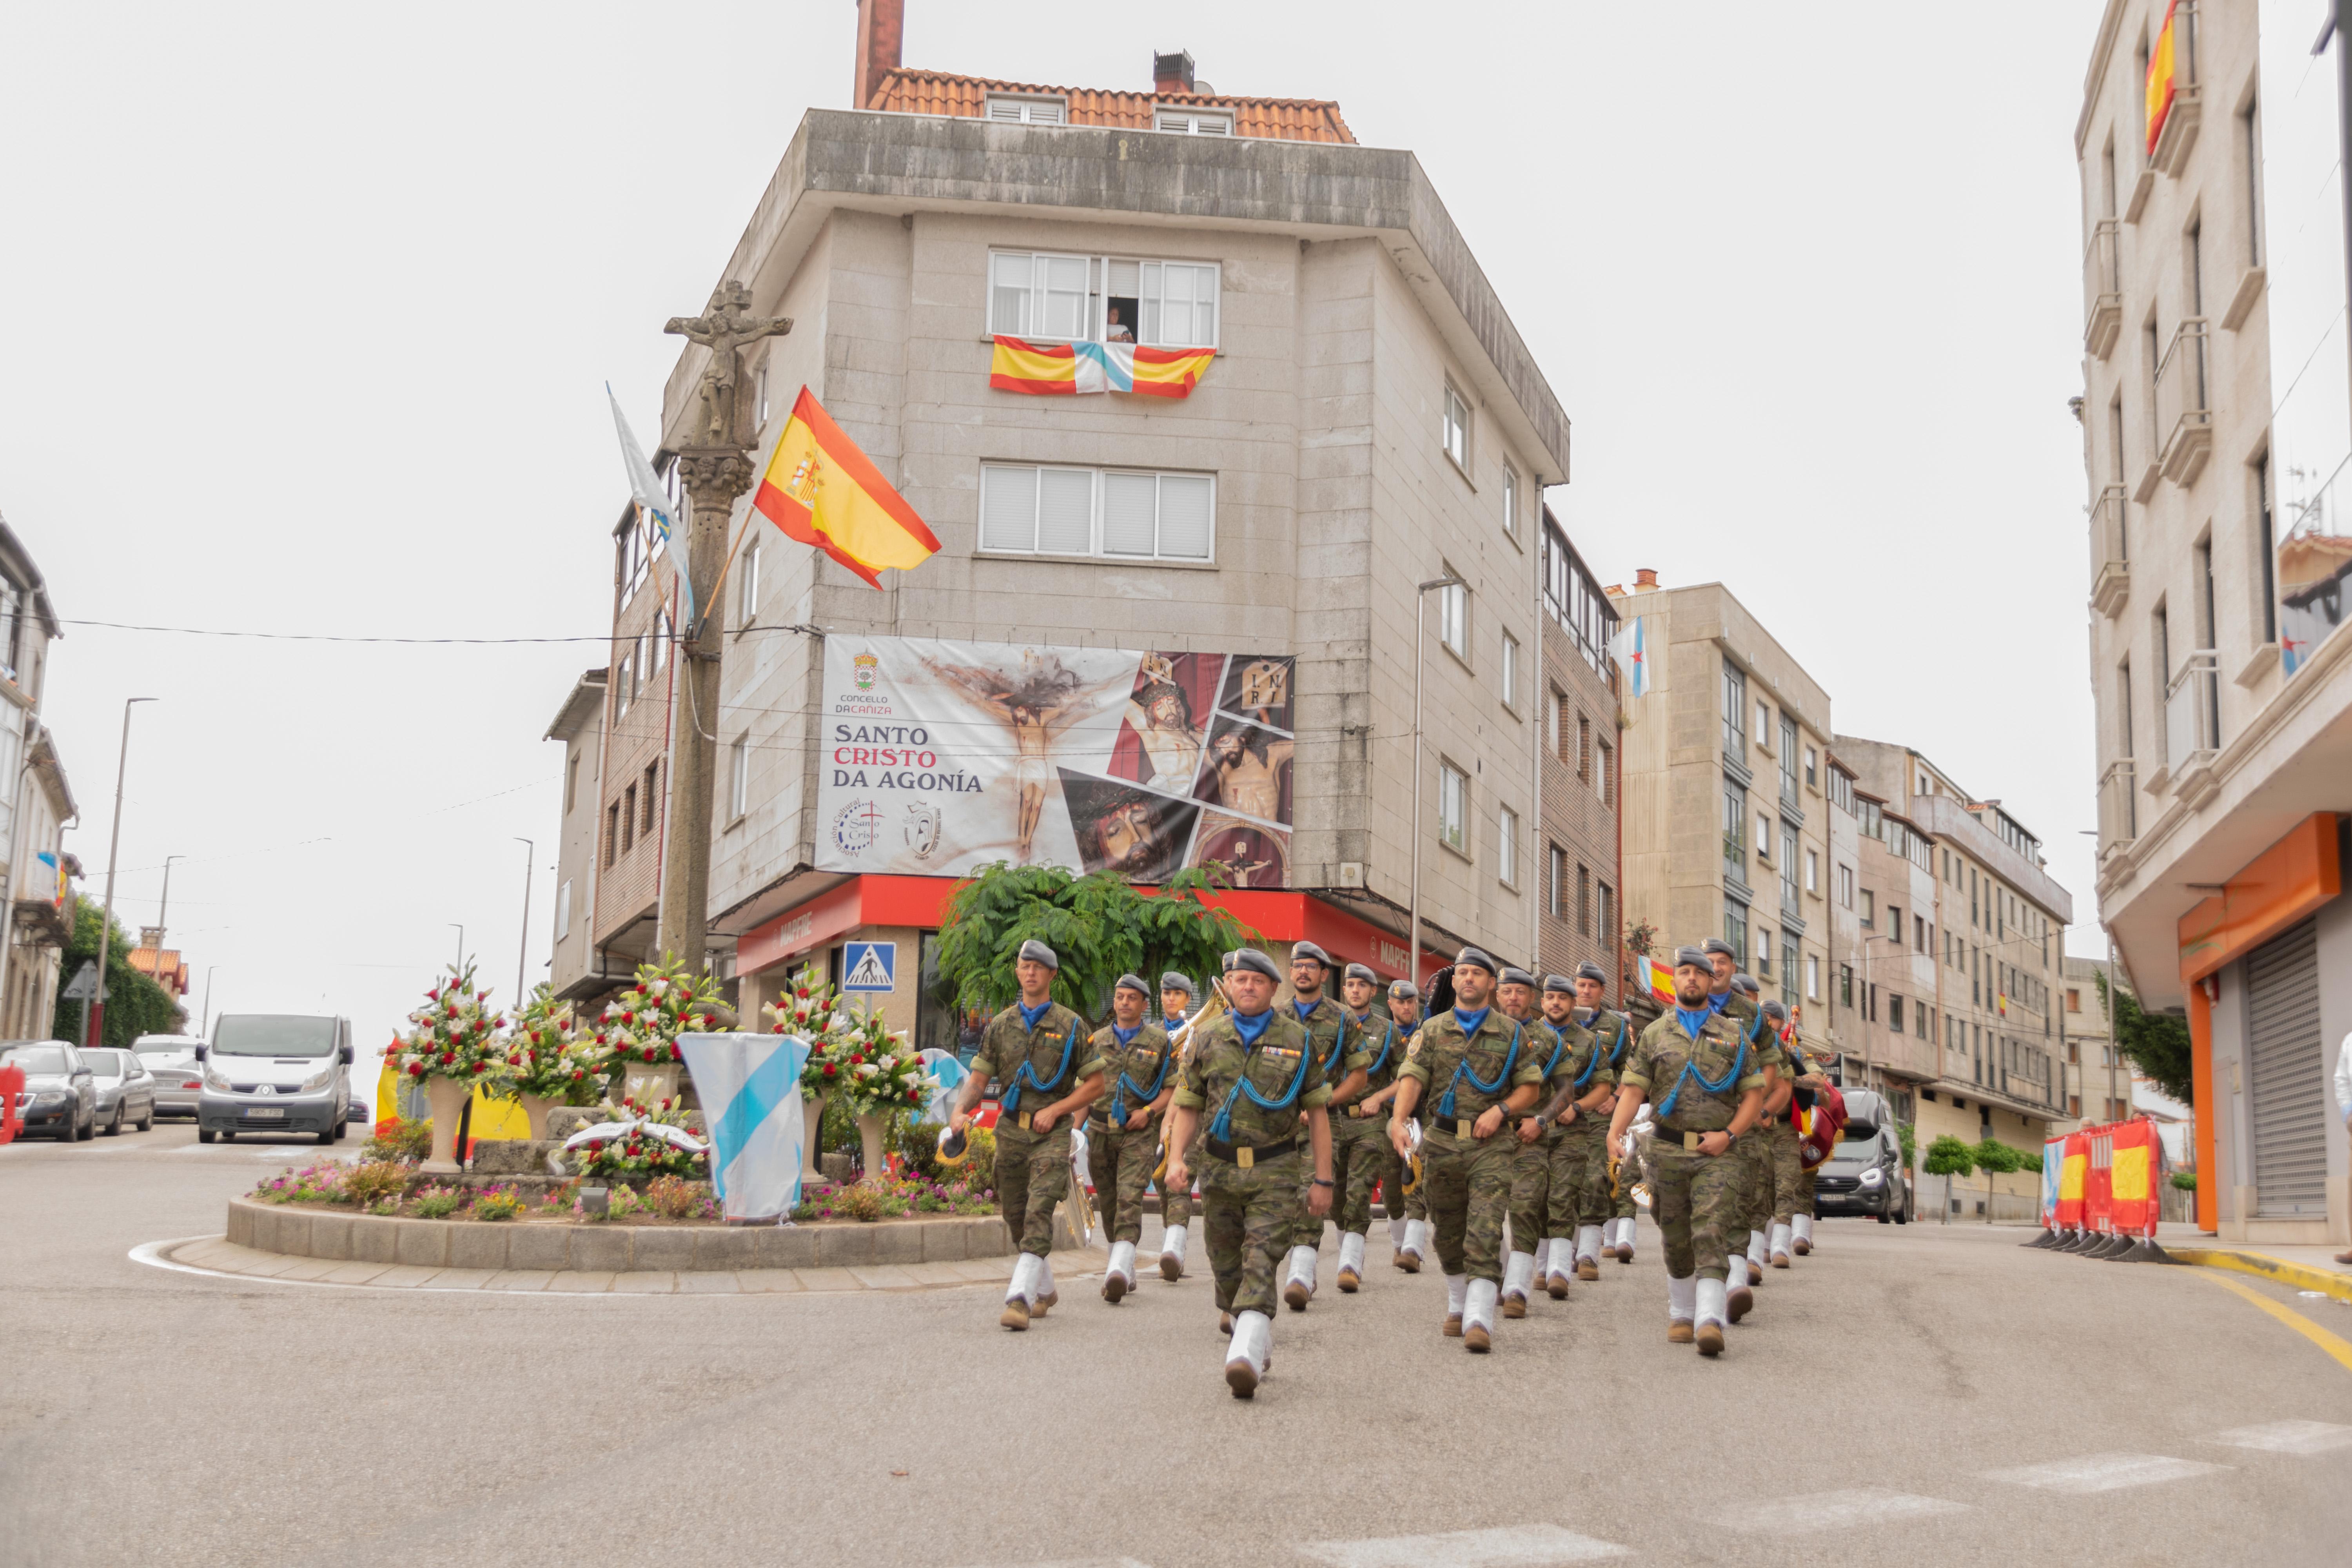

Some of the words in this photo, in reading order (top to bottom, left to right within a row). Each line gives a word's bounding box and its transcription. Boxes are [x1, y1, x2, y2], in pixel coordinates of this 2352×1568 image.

[840, 695, 888, 703] CONCELLO
[835, 724, 928, 745] SANTO
[834, 747, 936, 768] CRISTO
[833, 769, 869, 788] DA
[877, 769, 984, 793] AGONÍA
[833, 797, 860, 823] Cultural
[830, 826, 860, 858] Asociación
[780, 911, 812, 947] MAPFRE
[1380, 940, 1410, 973] MAPFR
